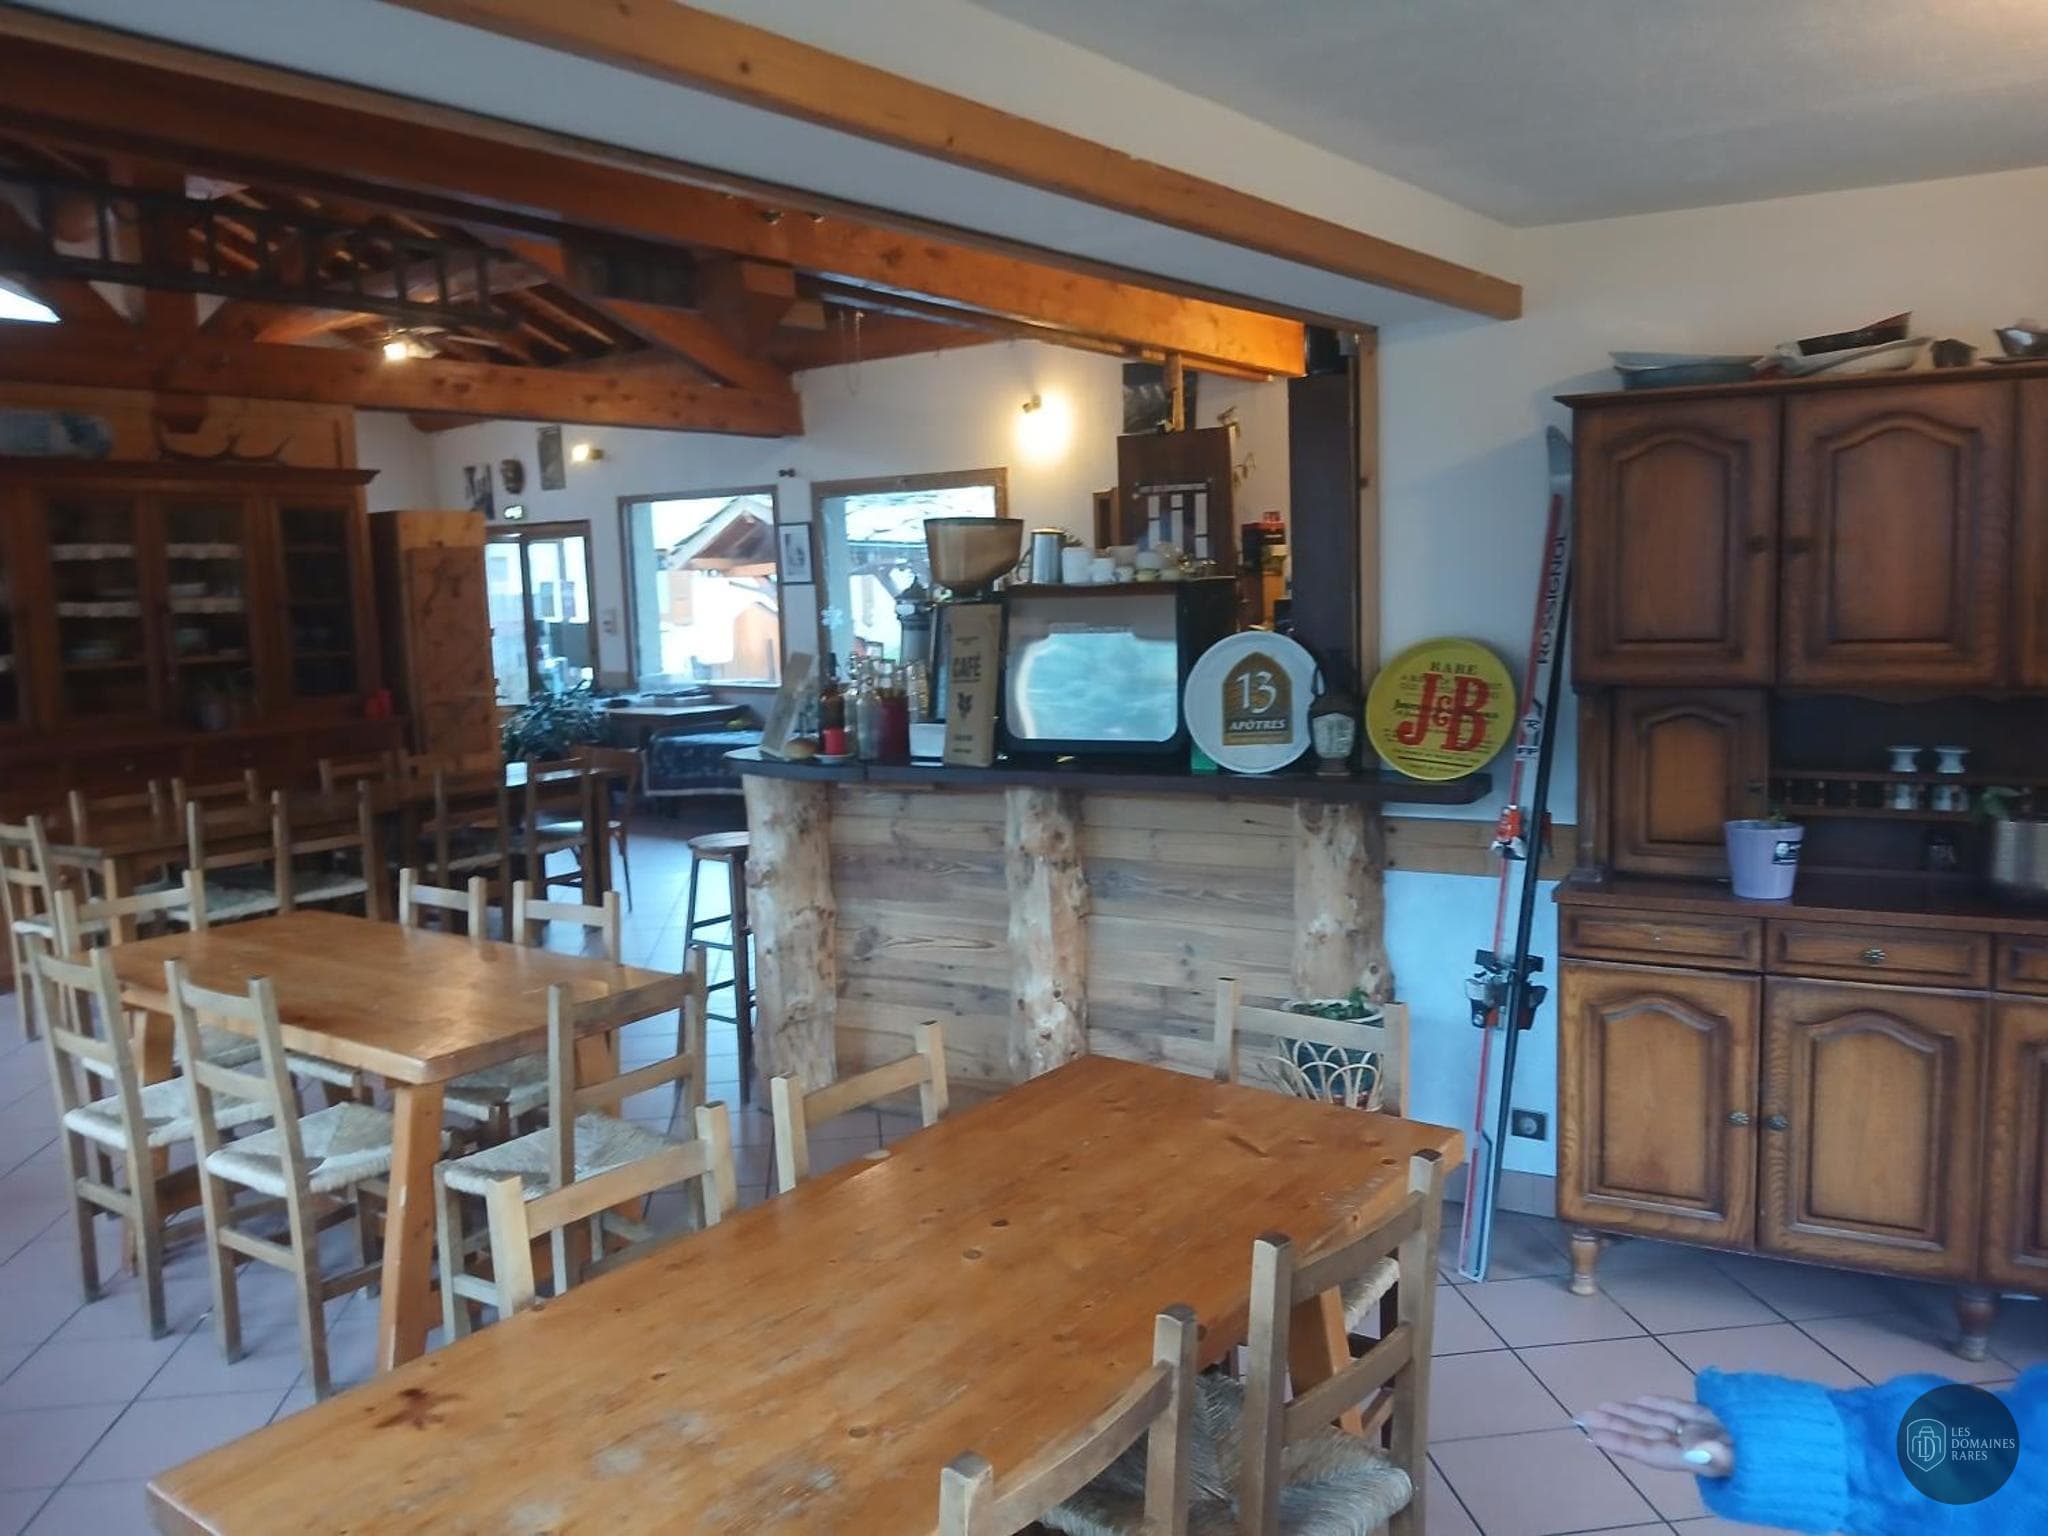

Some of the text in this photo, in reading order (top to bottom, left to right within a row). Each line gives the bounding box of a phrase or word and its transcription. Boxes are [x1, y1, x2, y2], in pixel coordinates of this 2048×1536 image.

[1537, 535, 1566, 665] ROSSIGNOL
[1429, 661, 1479, 675] RARE
[1235, 671, 1277, 714] 13
[1396, 672, 1490, 751] J&B
[1228, 718, 1287, 731] APÔTRES
